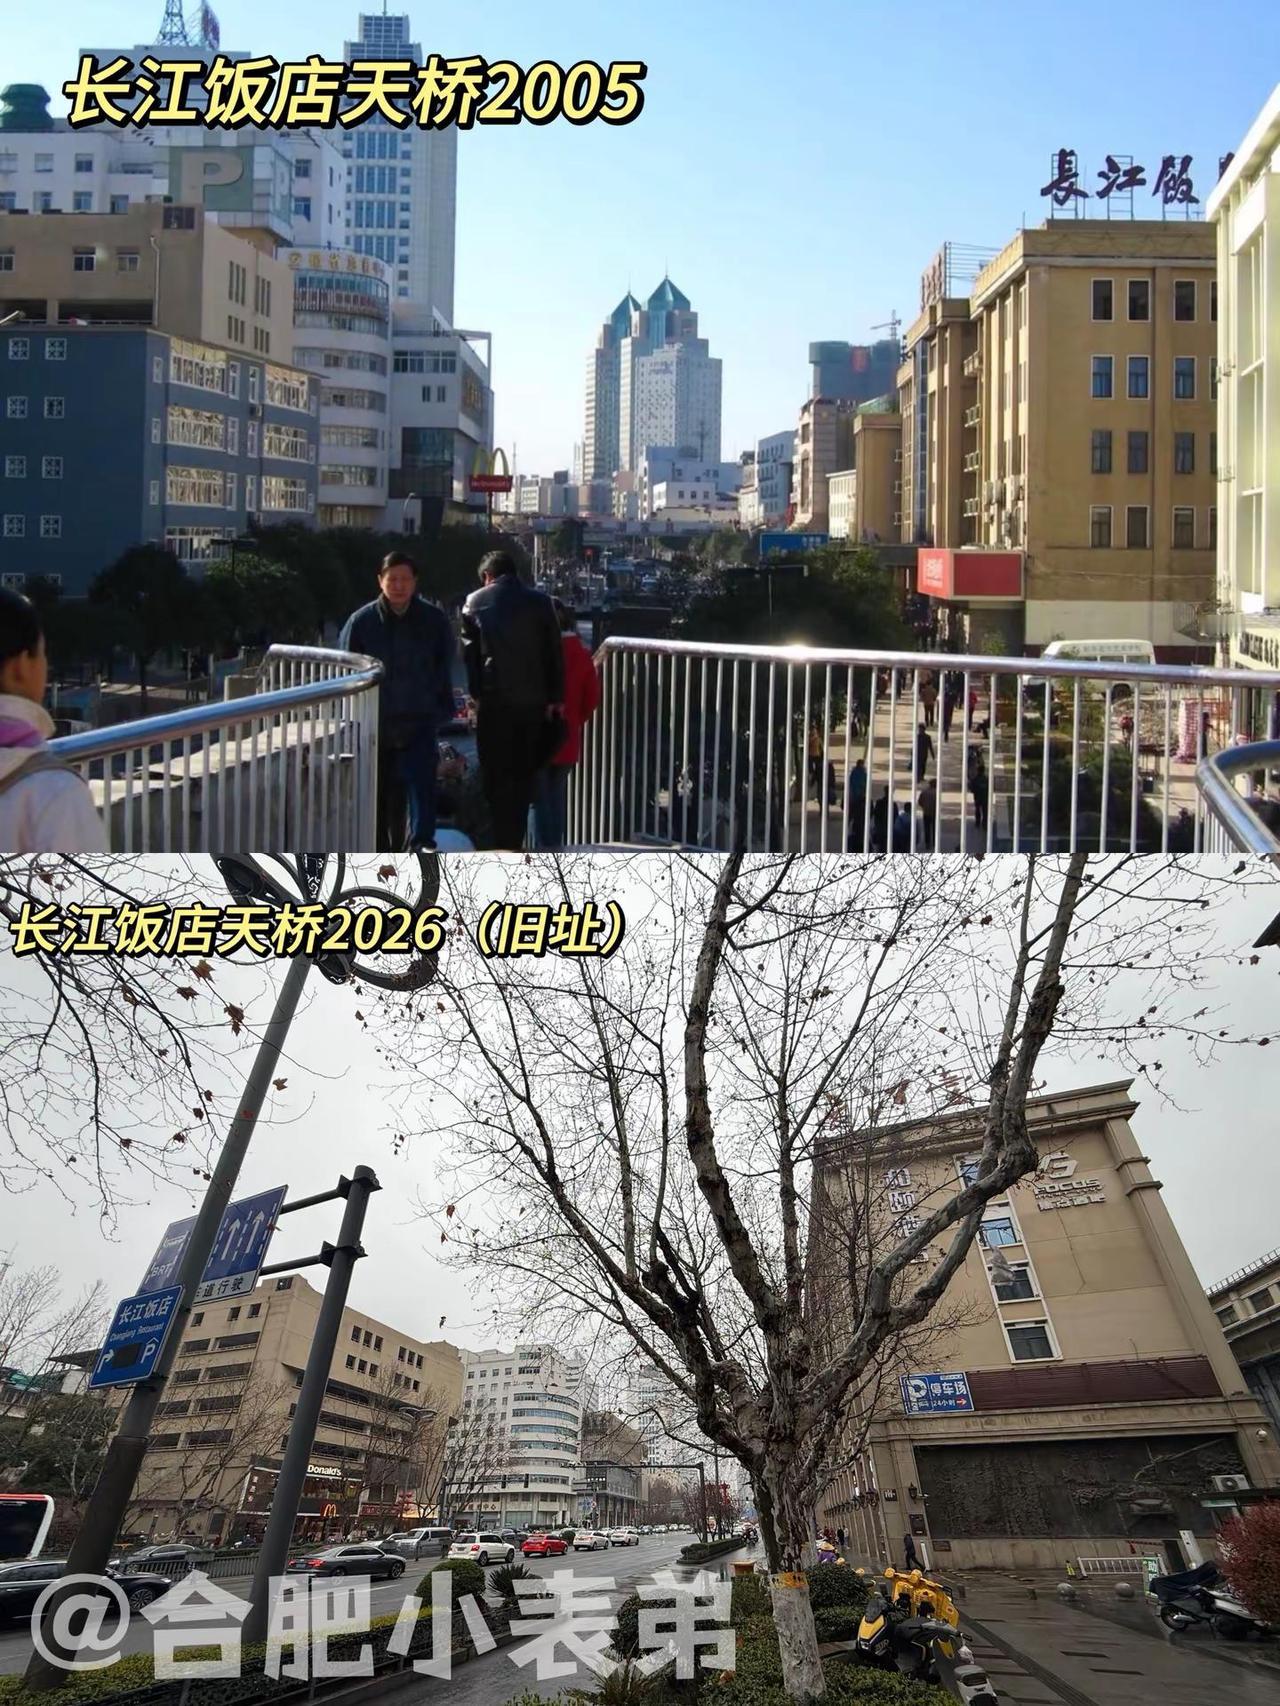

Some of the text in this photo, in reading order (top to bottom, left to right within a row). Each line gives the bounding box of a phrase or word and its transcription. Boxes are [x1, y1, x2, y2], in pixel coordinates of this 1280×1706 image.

[1034, 1179, 1101, 1195] FOCUS
[151, 1262, 172, 1277] BRT
[118, 1295, 174, 1325] 长江饭店
[140, 1343, 156, 1364] P
[930, 1381, 968, 1397] 停车场
[307, 1463, 342, 1477] Donald's
